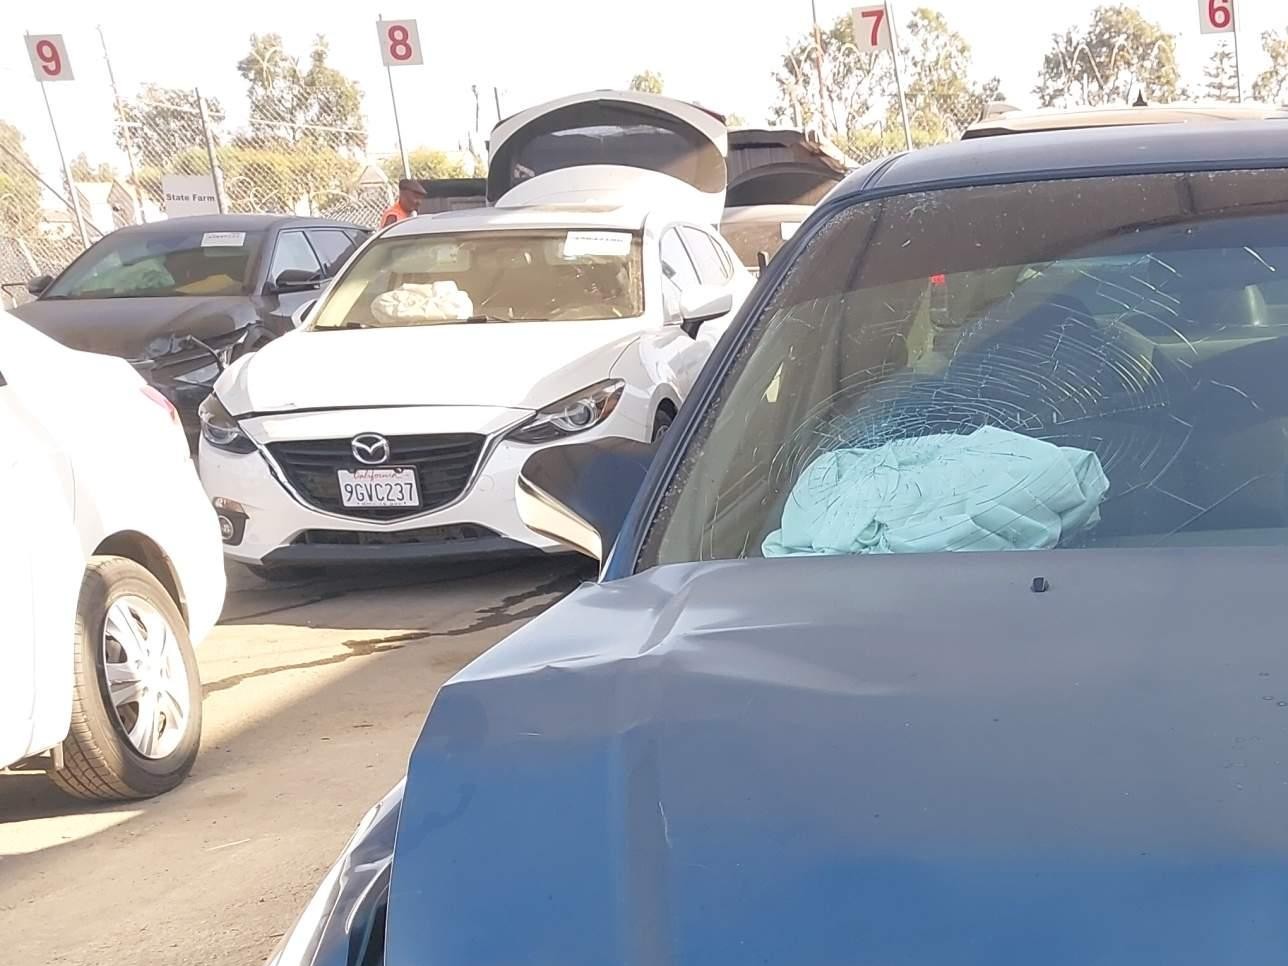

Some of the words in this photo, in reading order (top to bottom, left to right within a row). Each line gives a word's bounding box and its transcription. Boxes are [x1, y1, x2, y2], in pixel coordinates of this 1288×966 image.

[861, 10, 884, 46] 7
[1209, 0, 1230, 28] 6
[36, 39, 61, 75] 9
[388, 25, 412, 60] 8
[166, 193, 189, 201] State
[192, 193, 215, 201] Farm
[344, 482, 414, 502] 9GVC237
